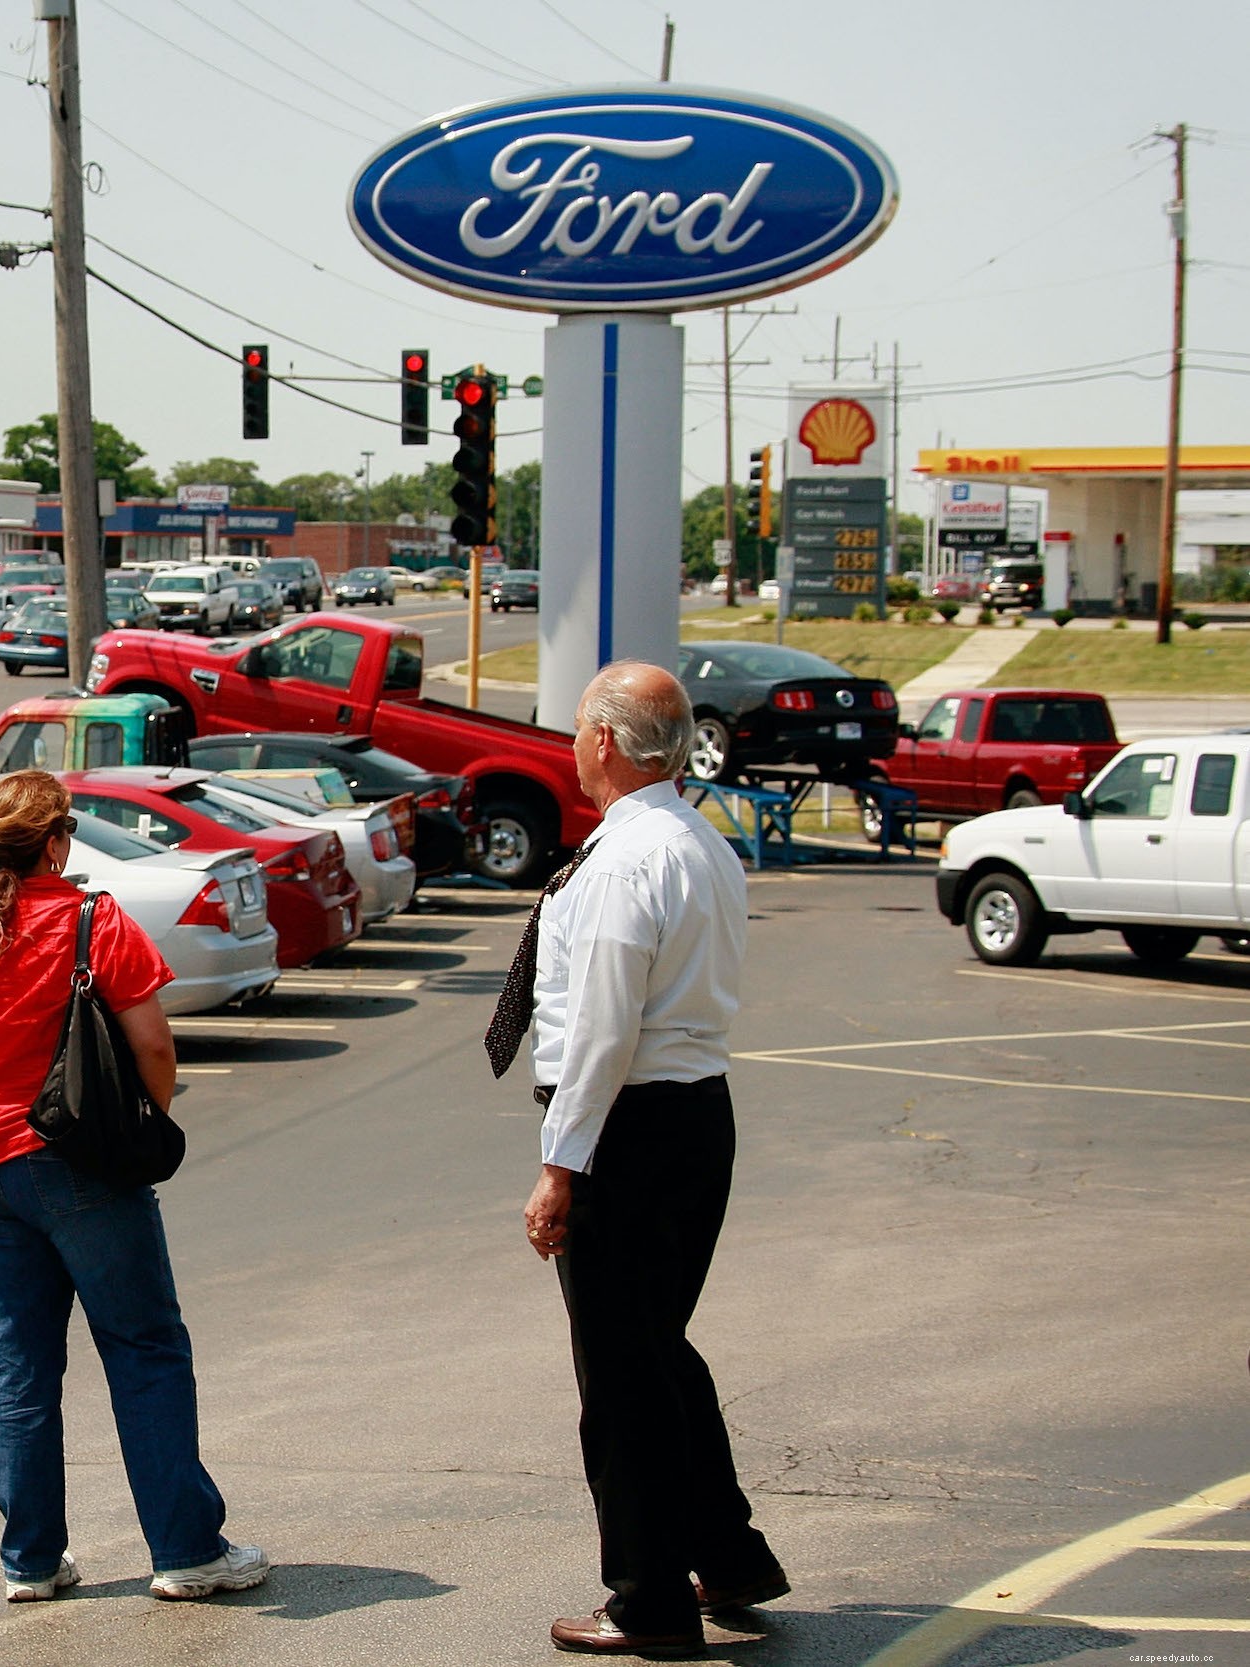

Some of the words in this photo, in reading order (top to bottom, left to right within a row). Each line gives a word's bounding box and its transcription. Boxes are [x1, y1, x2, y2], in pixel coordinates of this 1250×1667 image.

[458, 132, 774, 258] Ford
[946, 456, 1020, 474] Shell
[796, 485, 822, 495] Food
[795, 509, 814, 519] Car
[815, 509, 845, 519] Wash
[946, 532, 971, 544] BILL
[974, 532, 998, 544] KAY
